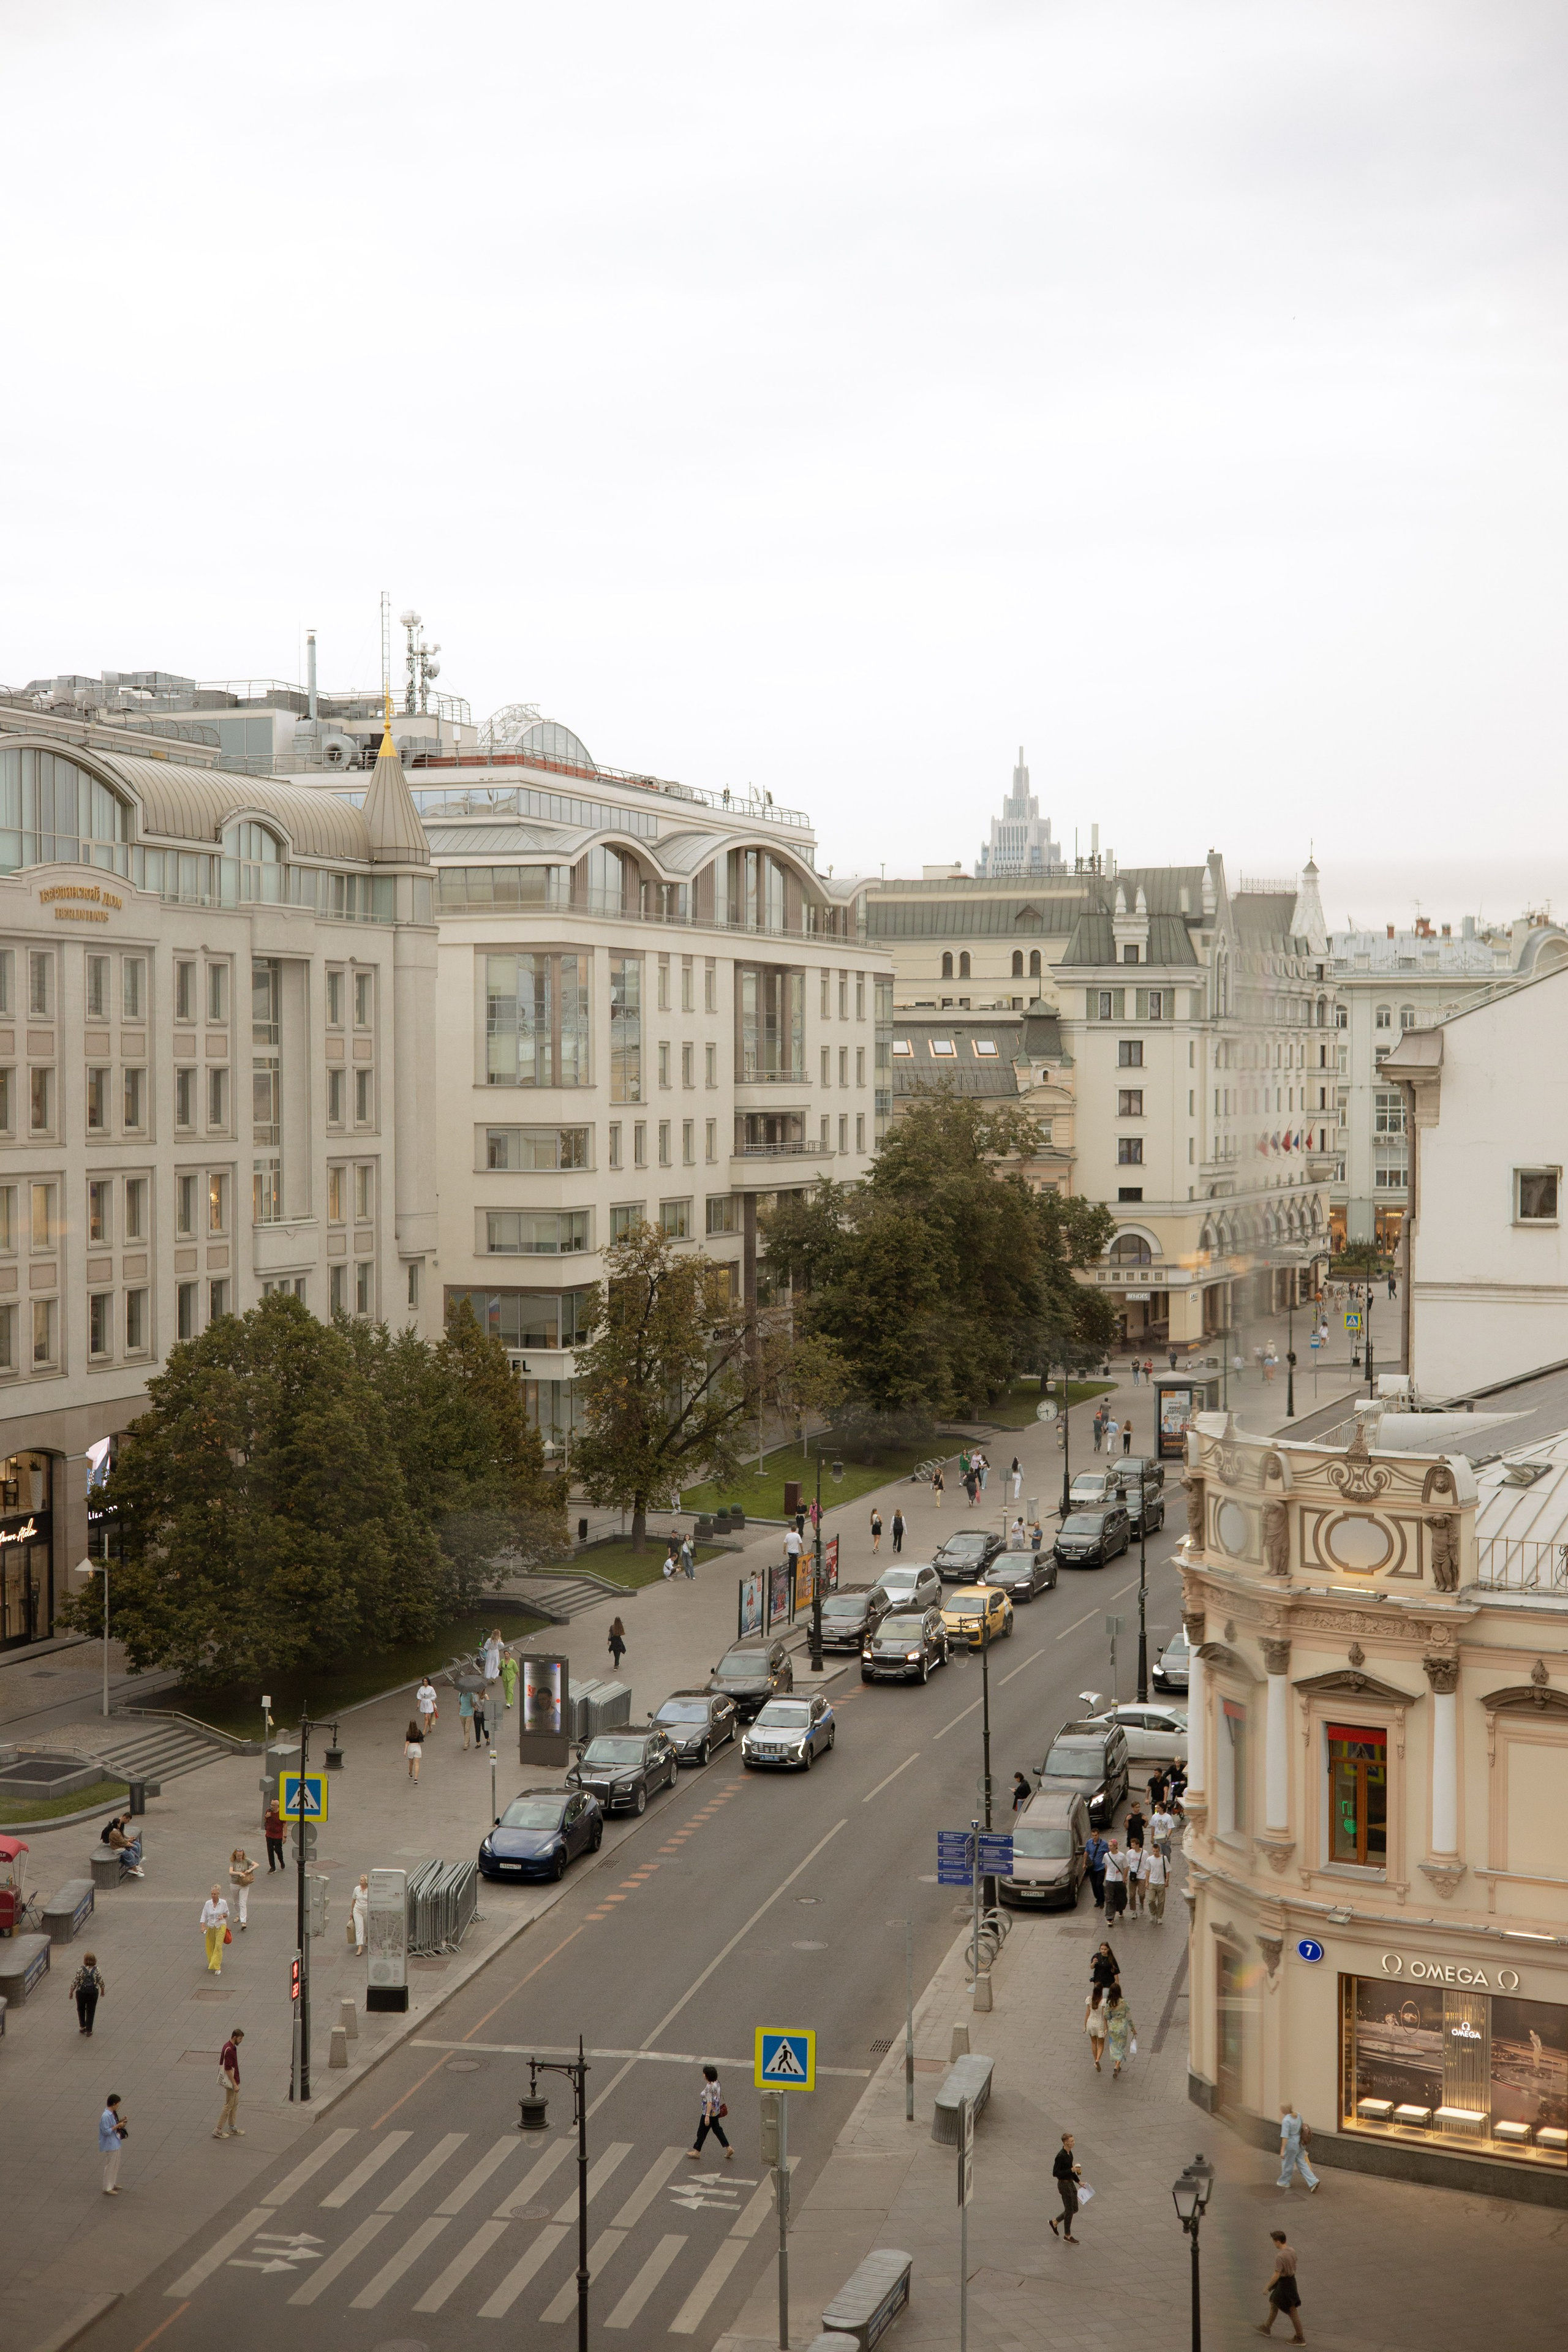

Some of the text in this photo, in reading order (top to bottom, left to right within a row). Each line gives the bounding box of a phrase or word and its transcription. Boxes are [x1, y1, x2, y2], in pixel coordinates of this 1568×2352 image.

[40, 886, 123, 910] БЕРЛИНСКИЙ ДОМ
[17, 1517, 37, 1542] Atelier
[1306, 1945, 1313, 1956] 7
[1410, 1961, 1489, 1987] OMEGA
[1451, 2029, 1481, 2040] OMEGA
